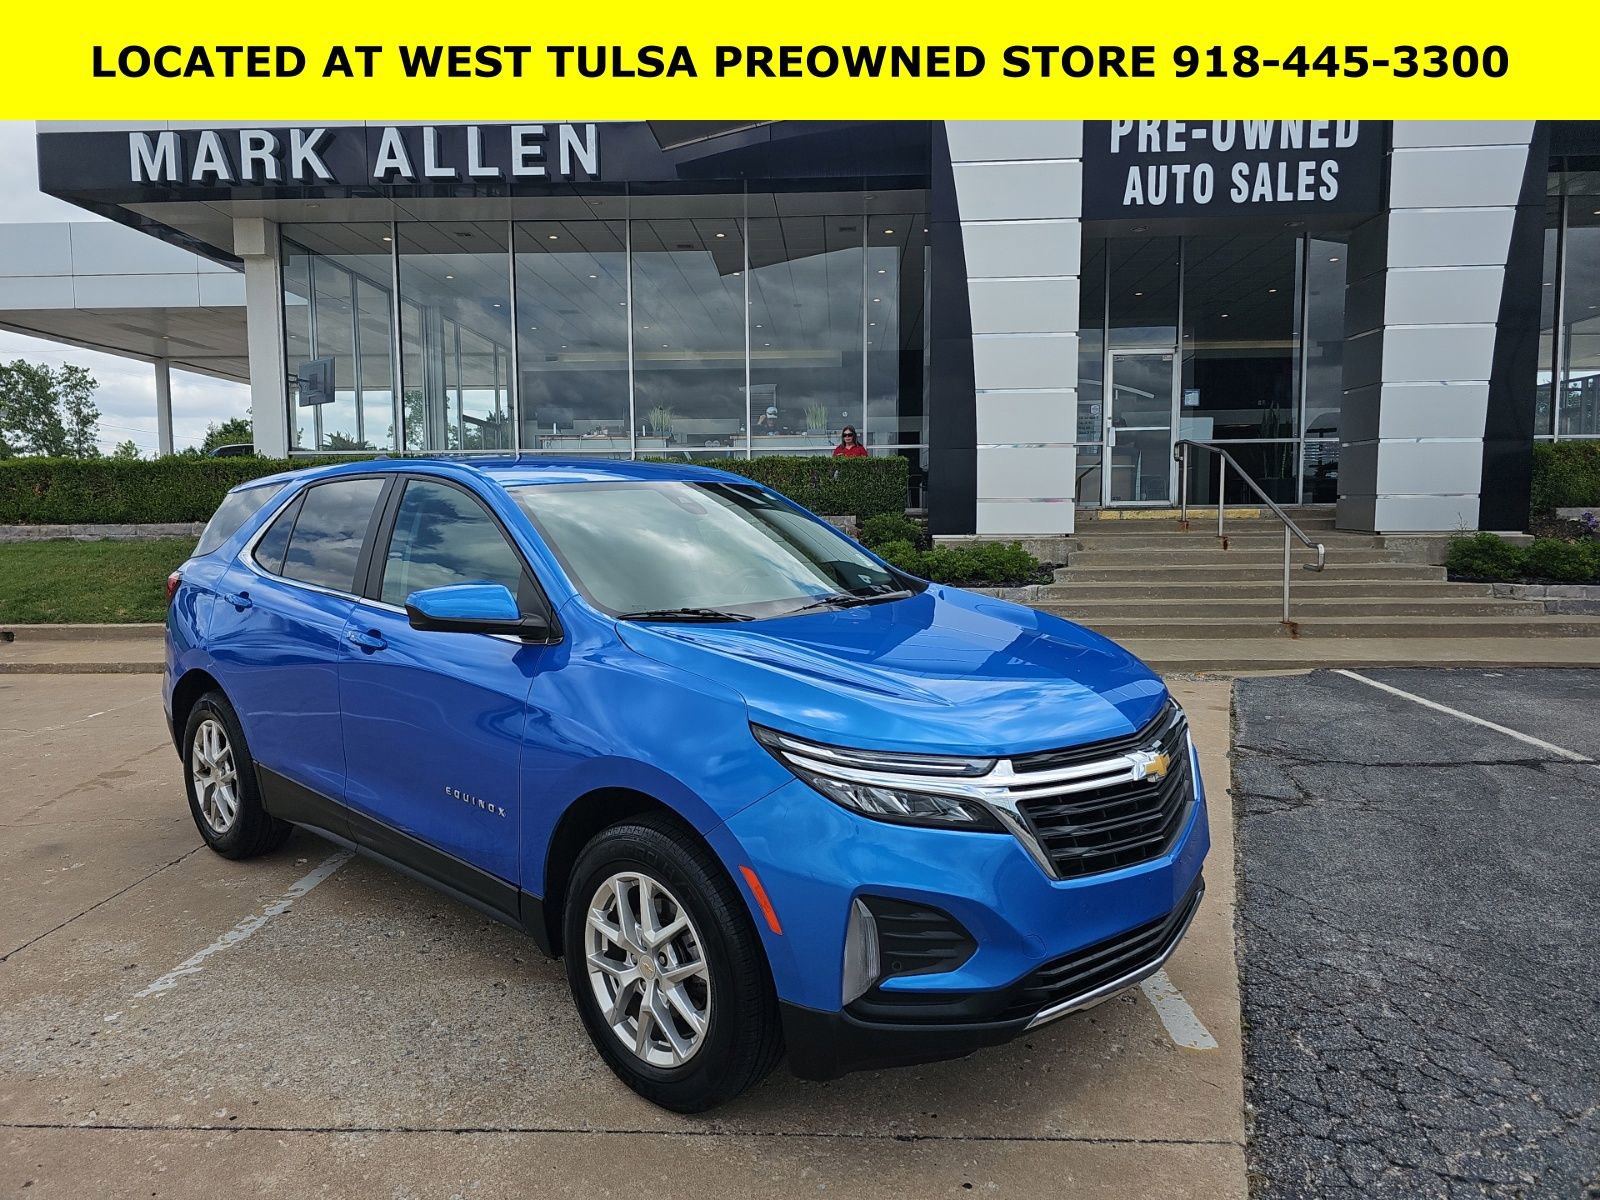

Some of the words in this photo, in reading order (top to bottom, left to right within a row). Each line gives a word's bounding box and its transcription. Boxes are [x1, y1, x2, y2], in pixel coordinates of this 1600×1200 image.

[129, 128, 335, 183] MARK
[373, 123, 599, 179] ALLEN
[1110, 120, 1360, 154] PRE-OWNED
[1122, 163, 1214, 206] AUTO
[1230, 159, 1339, 203] SALES
[445, 786, 506, 818] EQUINOX
